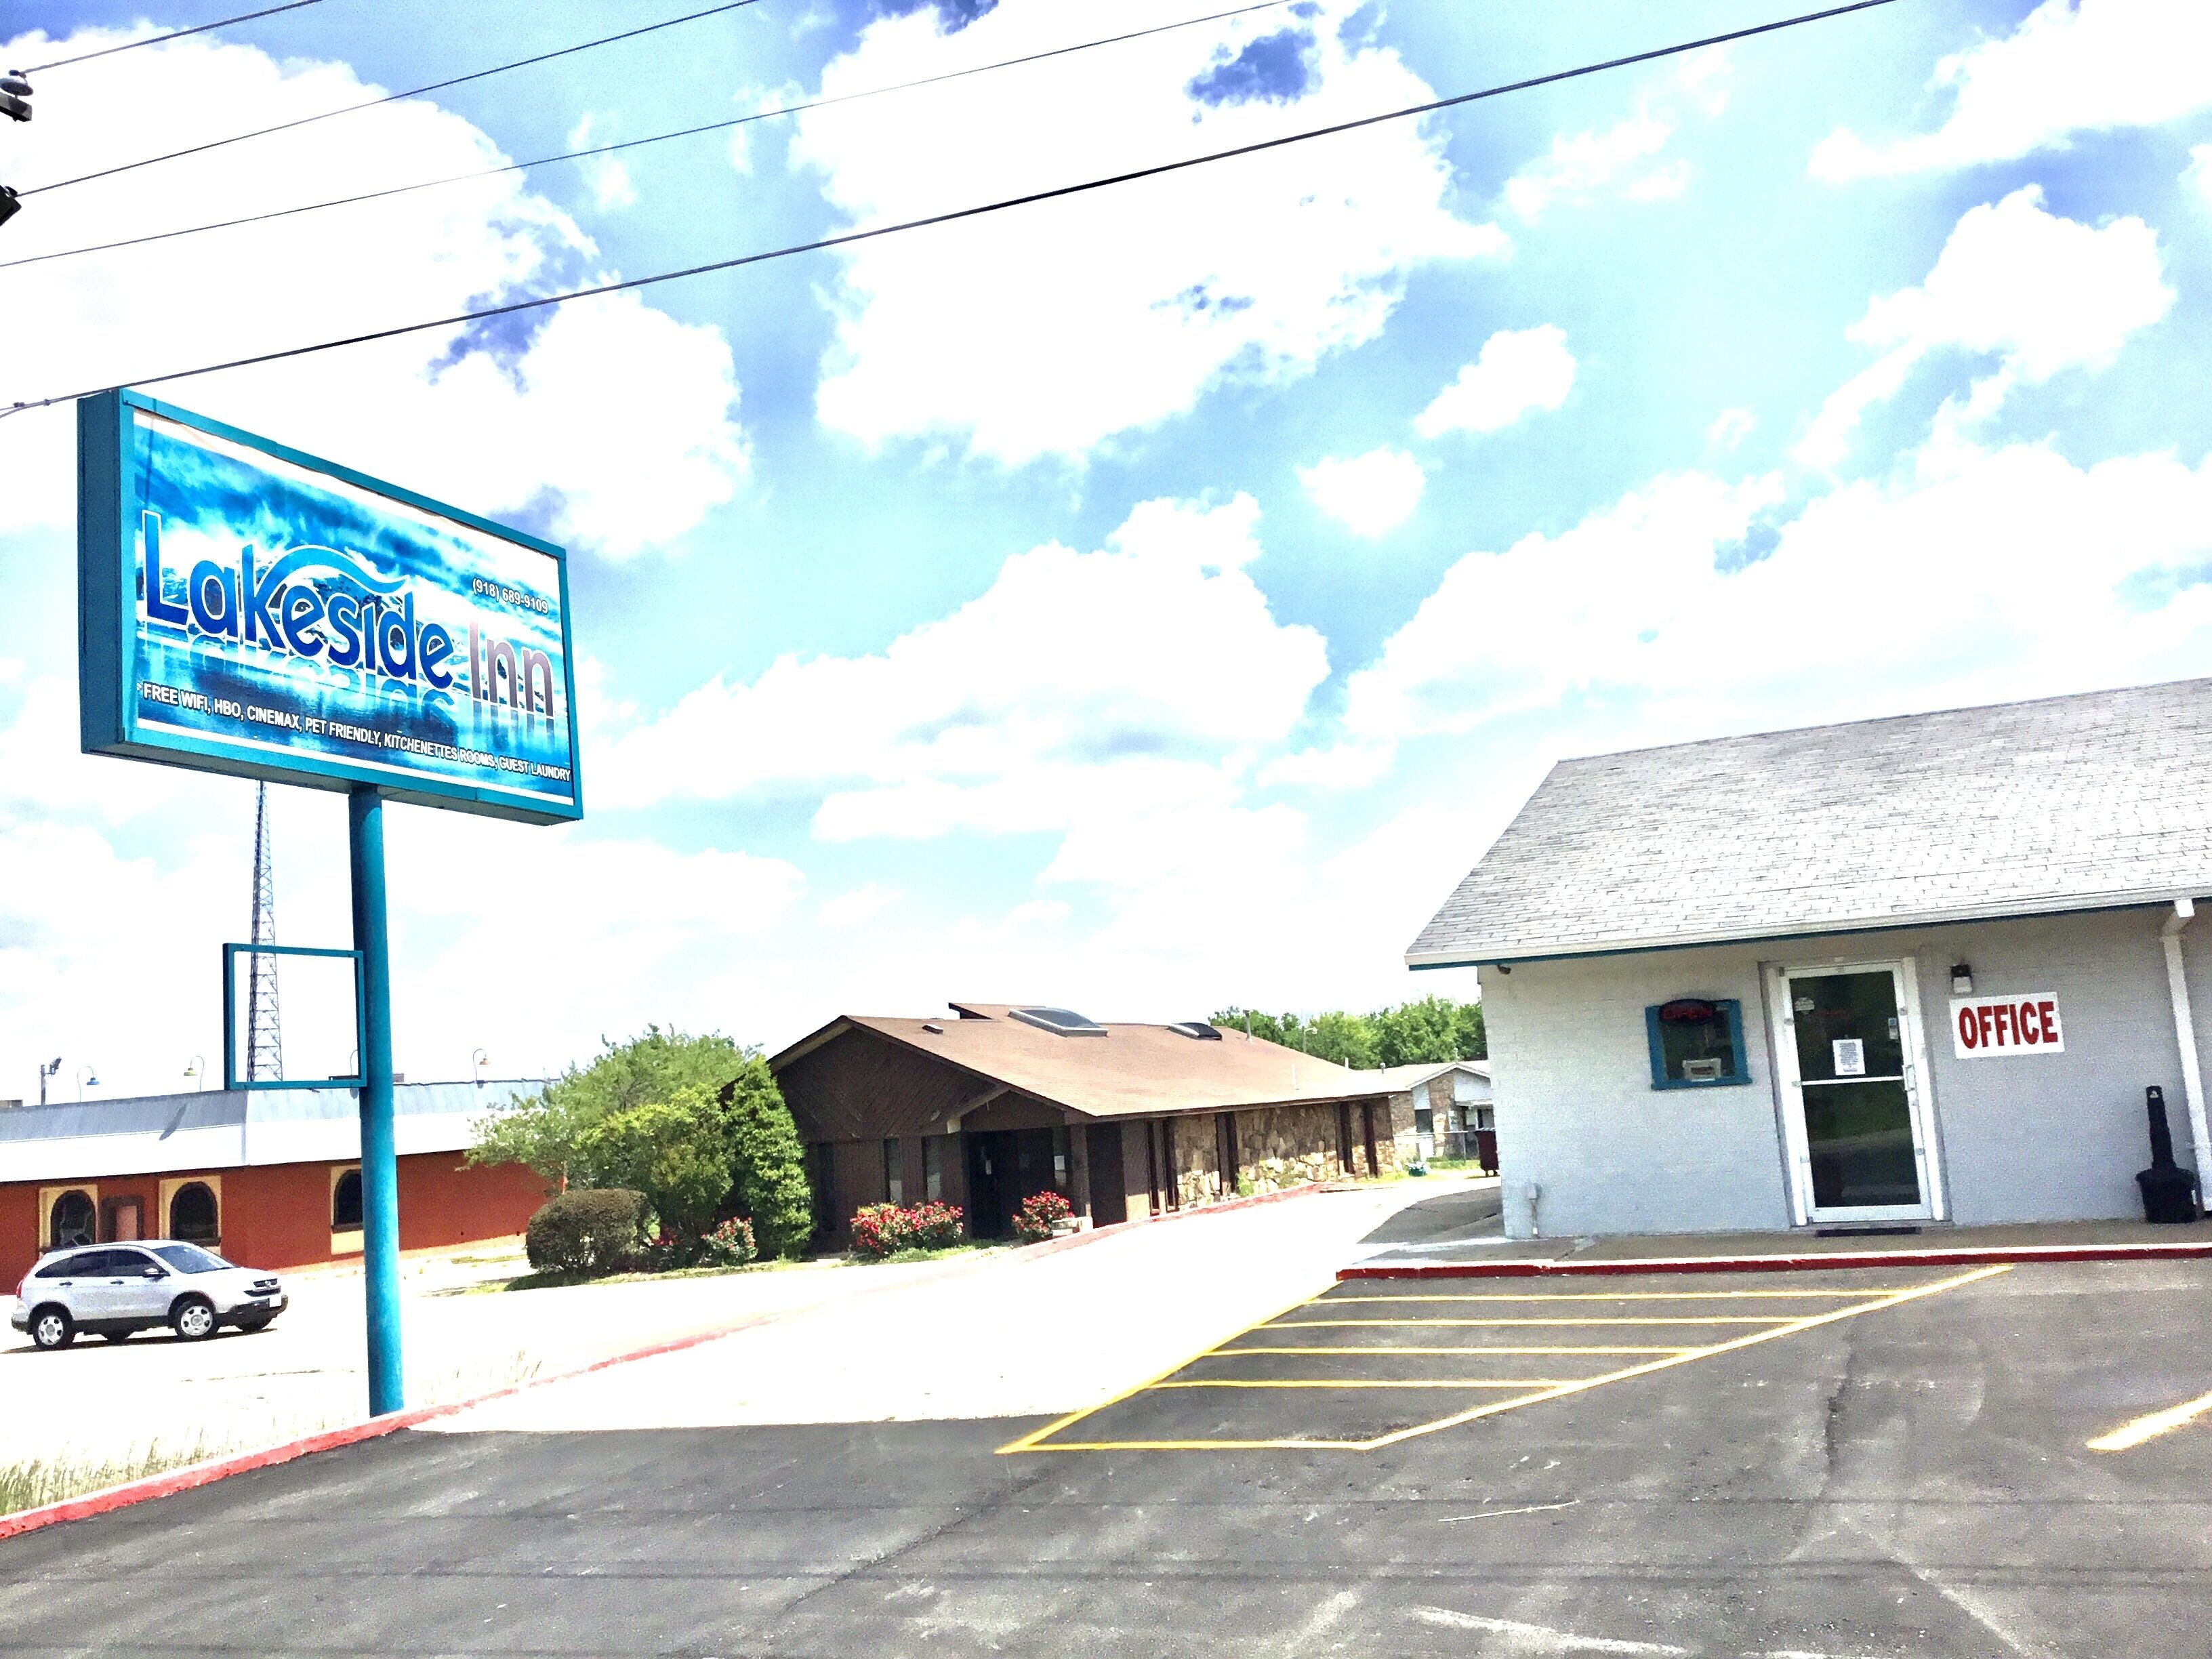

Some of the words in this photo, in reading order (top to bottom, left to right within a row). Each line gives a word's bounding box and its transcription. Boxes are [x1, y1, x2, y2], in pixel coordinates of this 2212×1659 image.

[142, 510, 455, 690] Lakeside
[469, 618, 554, 717] Inn
[472, 577, 499, 602] (918)
[502, 587, 548, 614] 689-9109
[143, 681, 179, 705] FREE
[180, 690, 211, 714] WIFI,
[214, 698, 244, 721] HBO,
[247, 705, 302, 733] CINEMAX,
[305, 717, 327, 735] PET
[329, 721, 382, 748] FRIENDLY,
[384, 734, 459, 761] KITCHENETTES
[459, 749, 498, 770] ROOMS,
[499, 757, 529, 774] GUEST
[530, 762, 571, 782] LAUNDRY
[1959, 1001, 2059, 1049] OFFICE
